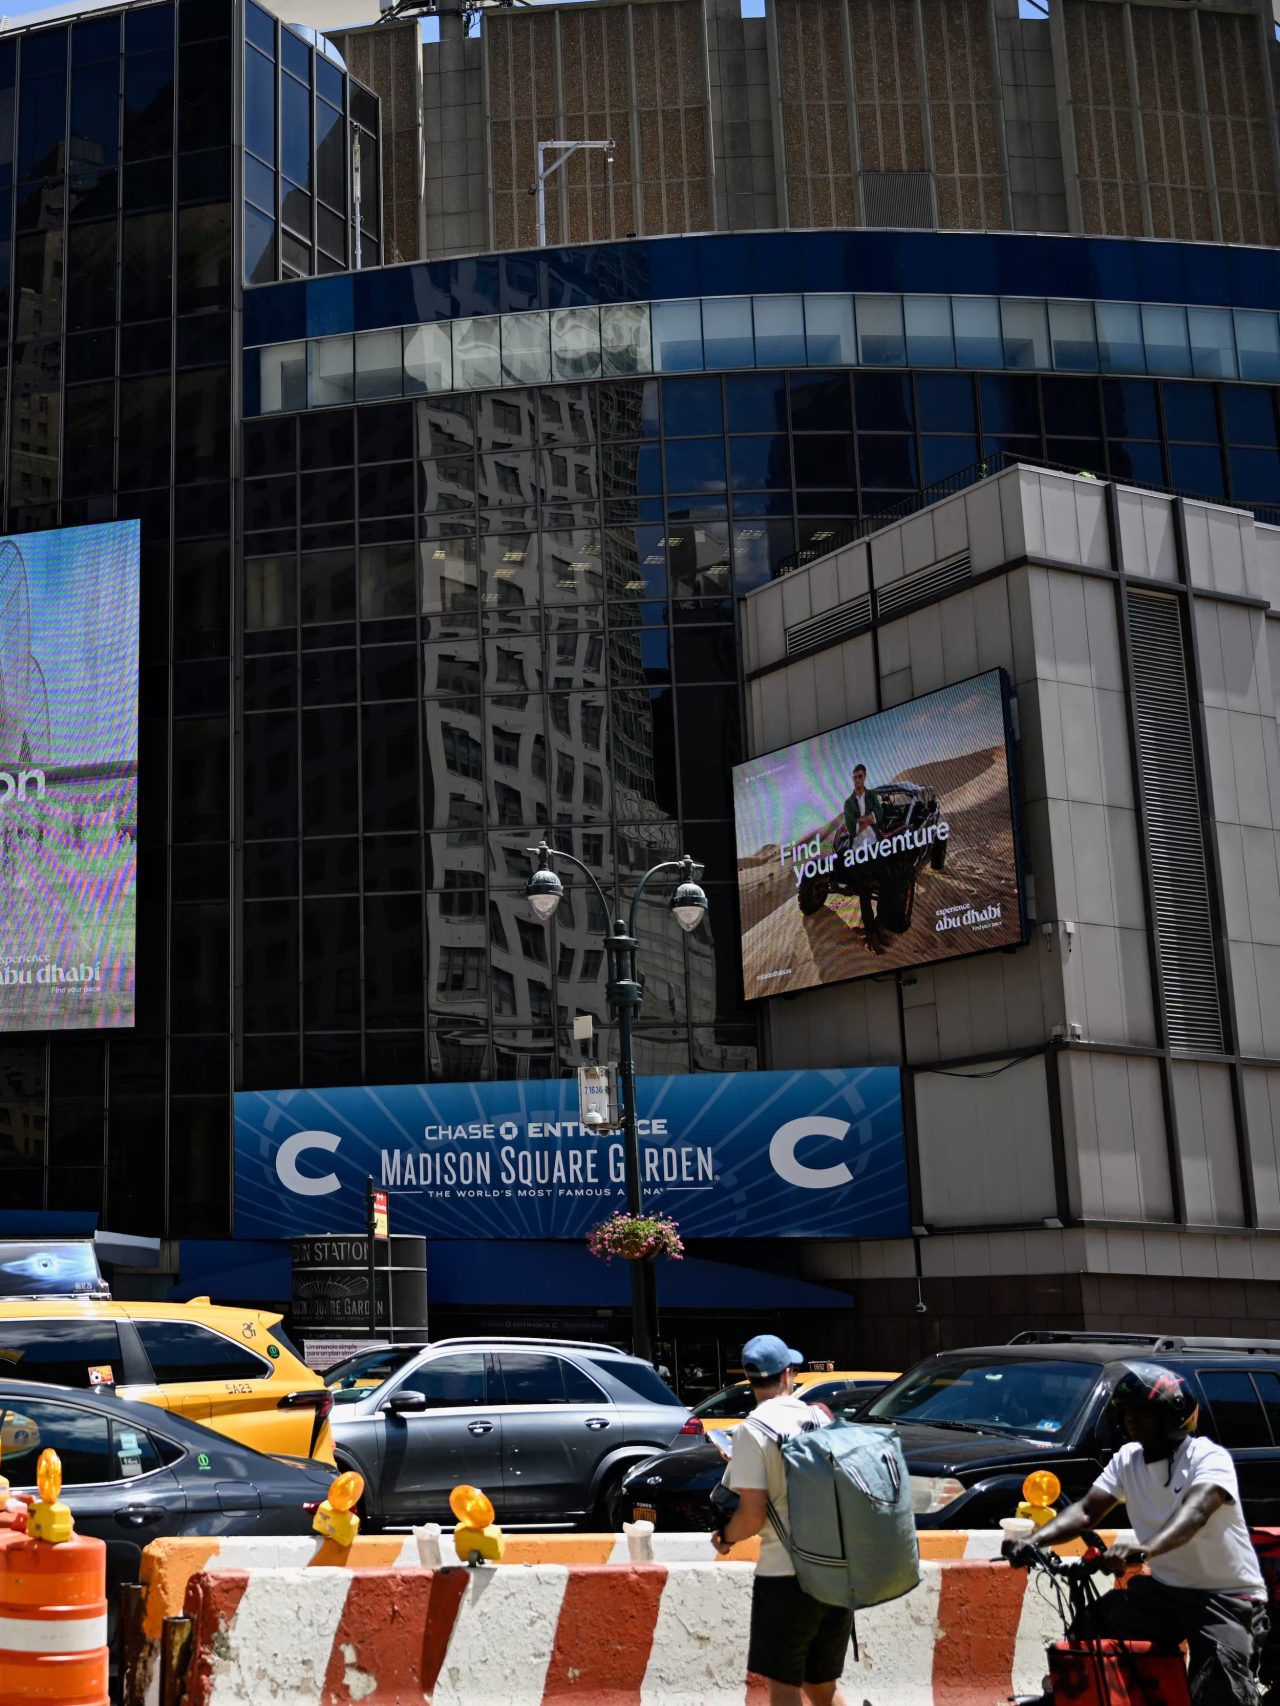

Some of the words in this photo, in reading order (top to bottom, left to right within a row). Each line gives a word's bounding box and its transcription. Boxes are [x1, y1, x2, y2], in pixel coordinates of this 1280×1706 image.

[780, 833, 821, 866] Find
[793, 853, 838, 888] your
[843, 821, 950, 868] adventure
[935, 903, 970, 916] experience
[935, 915, 961, 932] abu
[962, 902, 1002, 926] dhabi
[36, 961, 101, 984] dhabi
[51, 986, 66, 994] Find
[67, 987, 82, 995] your
[424, 1123, 495, 1141] CHASE
[527, 1119, 668, 1138] ENTRCE
[274, 1130, 342, 1196] C
[768, 1116, 855, 1189] C
[381, 1149, 491, 1187] MADISON
[500, 1145, 599, 1186] SQUARE
[609, 1143, 713, 1183] GRDEN
[427, 1190, 449, 1198] THE
[451, 1189, 512, 1198] WORLD'S
[517, 1189, 553, 1197] MOST
[558, 1188, 612, 1197] FAMOUS
[616, 1187, 662, 1196] ANA
[326, 1349, 340, 1357] plan
[338, 1343, 358, 1351] simple
